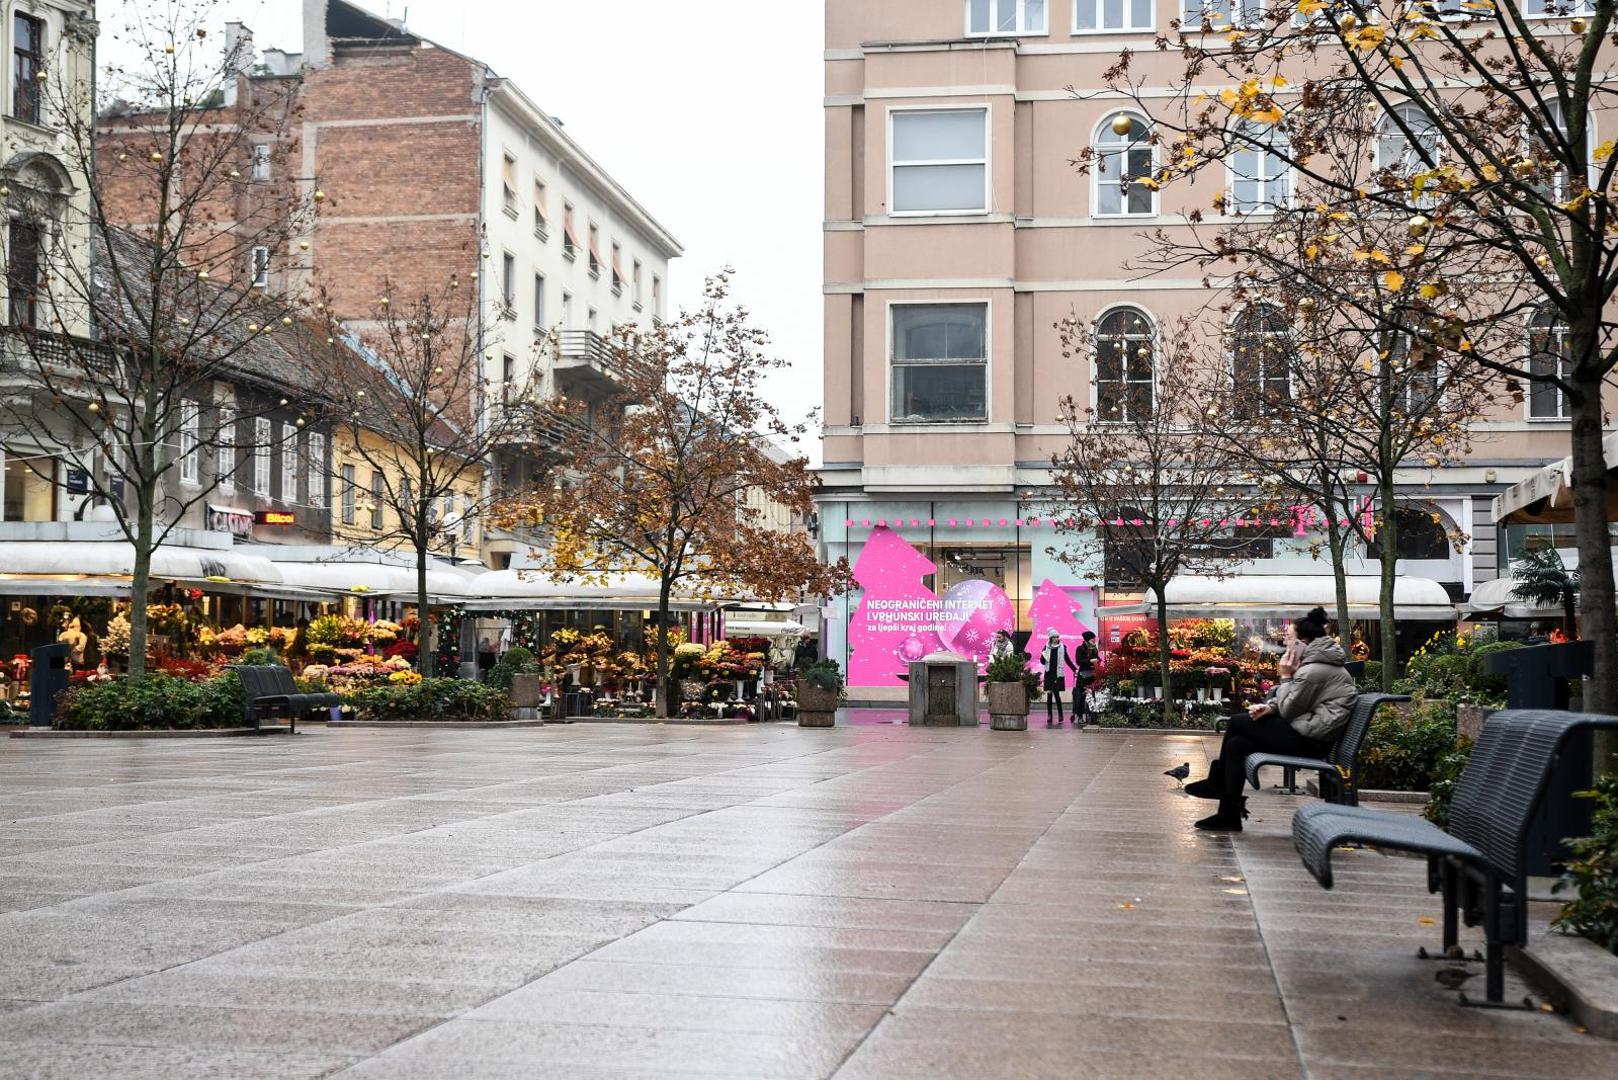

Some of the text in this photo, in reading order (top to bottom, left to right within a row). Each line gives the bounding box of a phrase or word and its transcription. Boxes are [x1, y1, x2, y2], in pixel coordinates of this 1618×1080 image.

[867, 597, 993, 609] NEOGRANIČENI INTERNET
[872, 612, 923, 621] VRHUNSKI
[878, 623, 899, 632] ljepši
[901, 623, 916, 632] kraj
[918, 623, 946, 632] godine!
